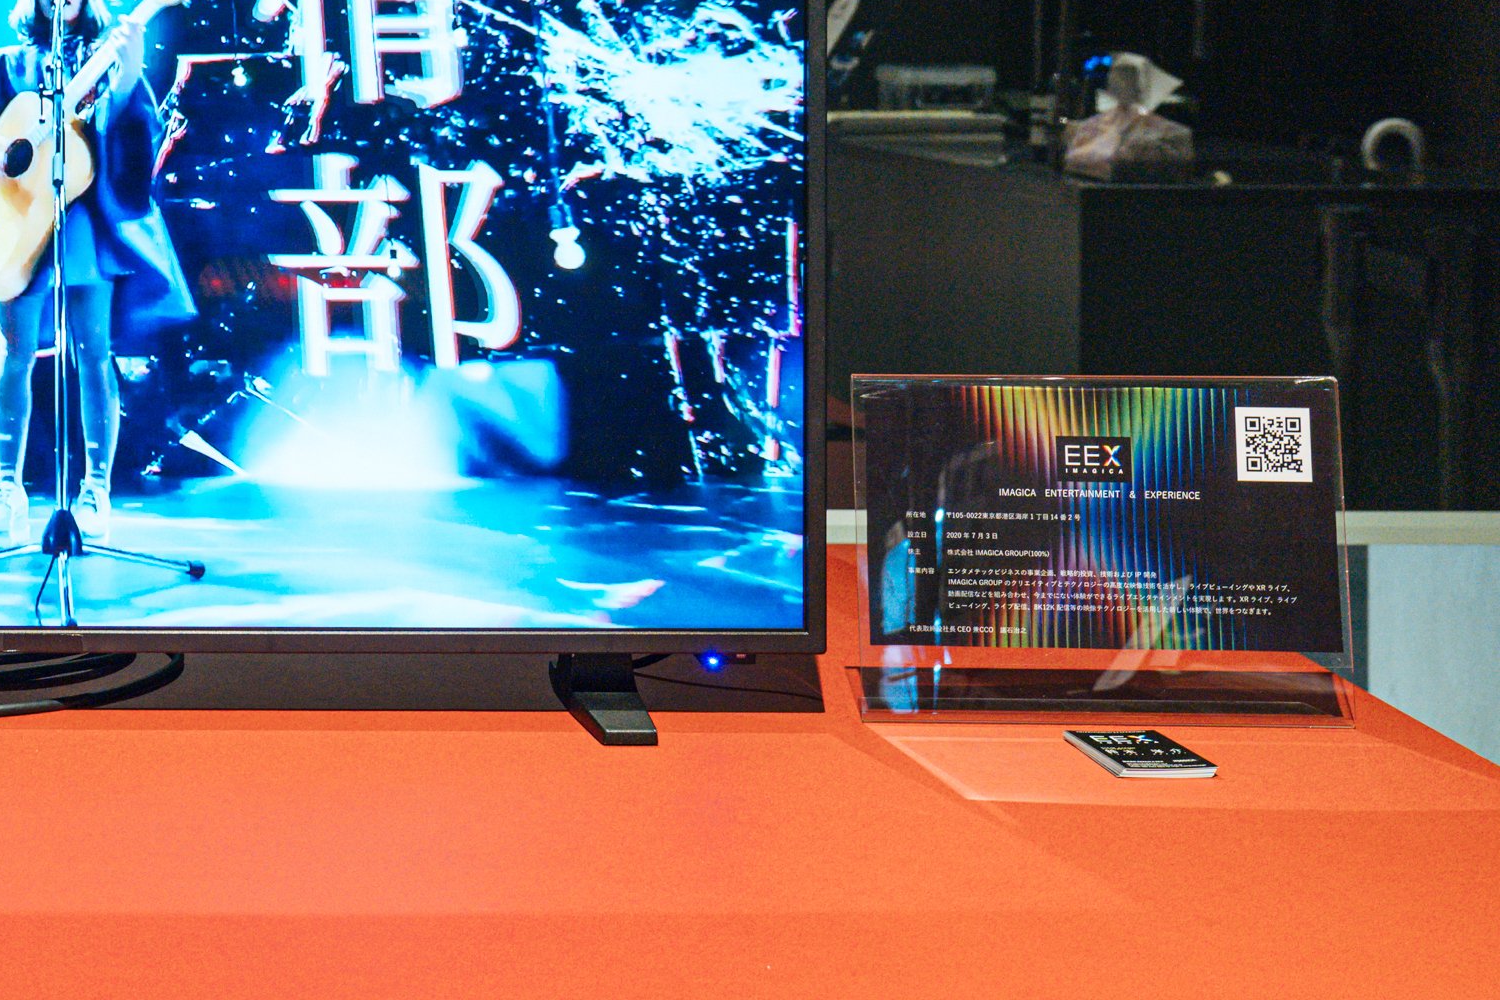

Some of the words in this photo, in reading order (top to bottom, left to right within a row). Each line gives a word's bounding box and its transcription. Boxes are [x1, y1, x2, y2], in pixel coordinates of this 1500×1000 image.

[266, 153, 523, 377] 部
[1064, 445, 1122, 466] EEX
[998, 488, 1036, 497] IMAGICA
[1044, 488, 1120, 498] ENTERTAINMENT
[1129, 490, 1136, 499] &
[1144, 490, 1201, 500] EXPERIENCE
[1004, 550, 1050, 558] GROUP(100%)
[948, 578, 978, 586] IMAGICA
